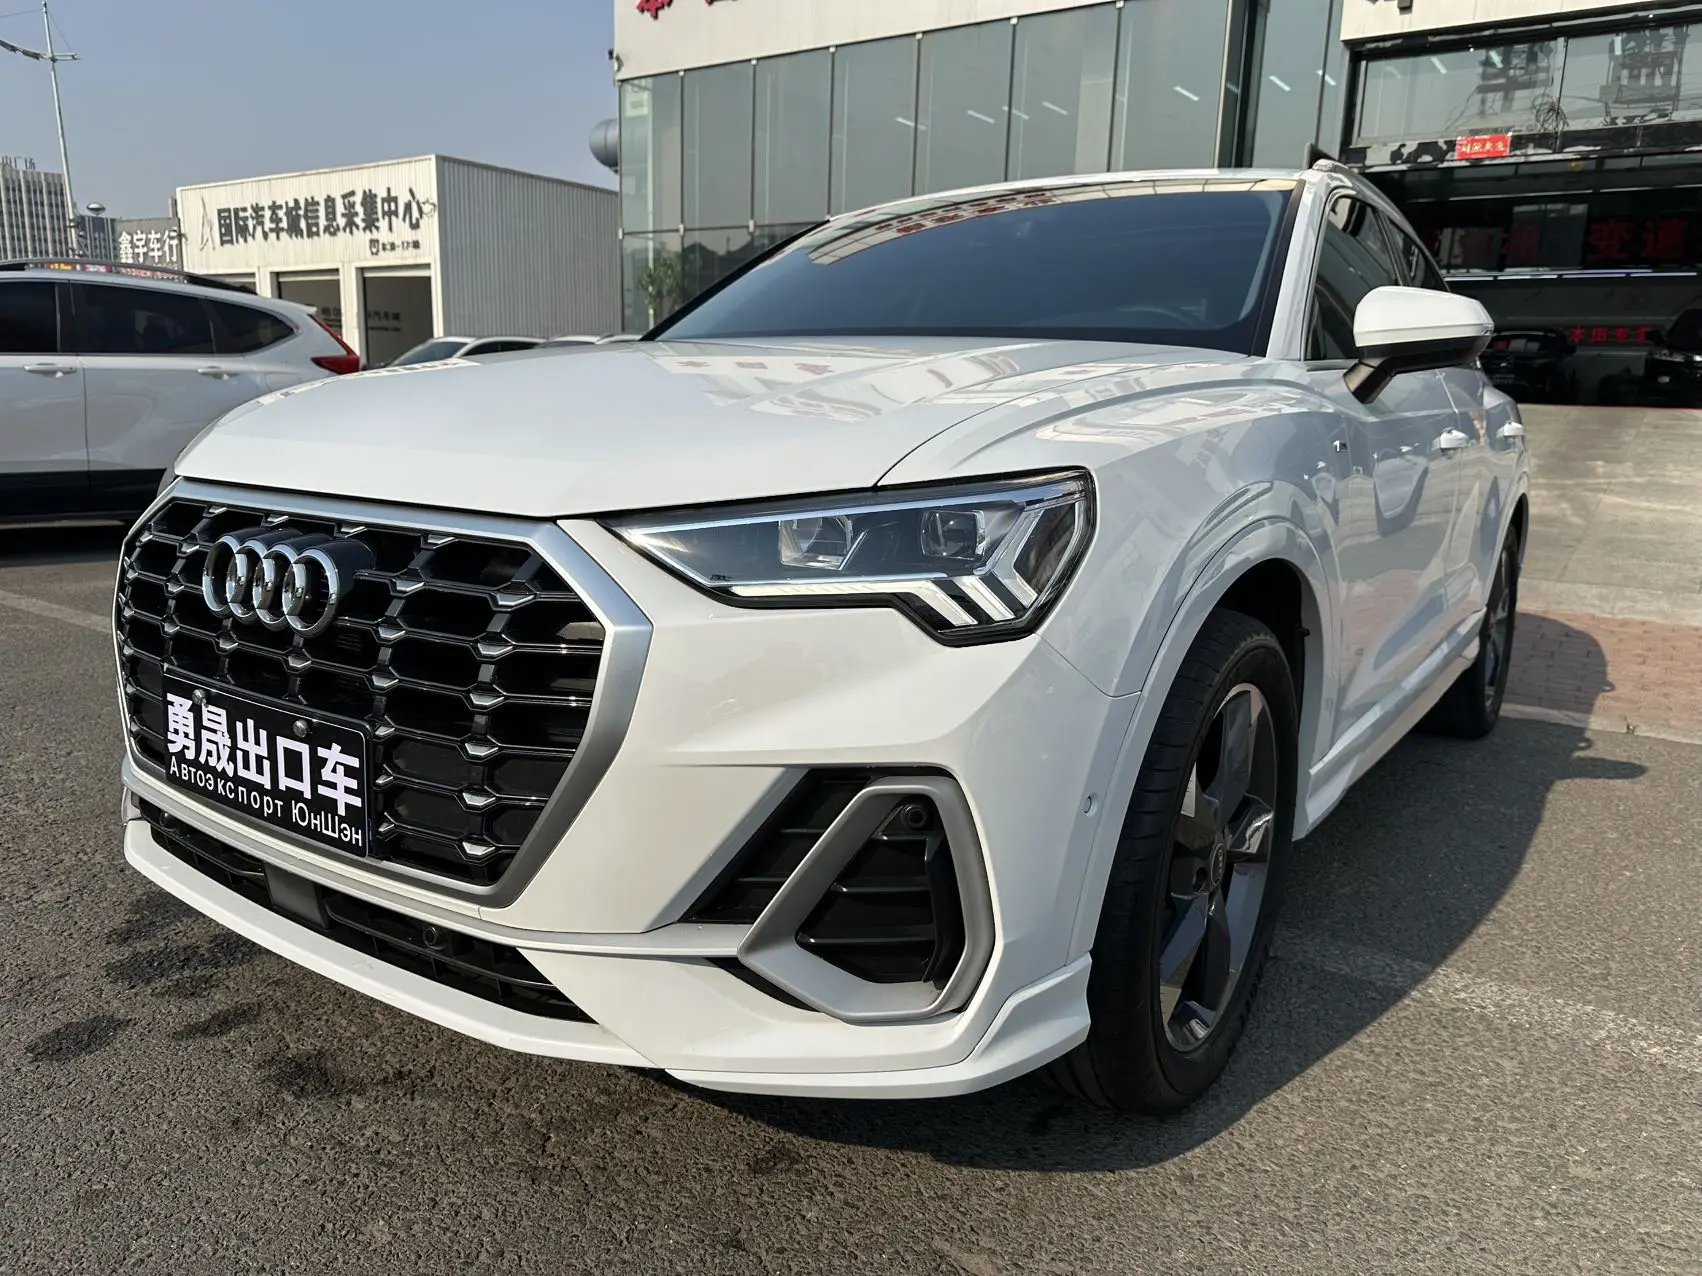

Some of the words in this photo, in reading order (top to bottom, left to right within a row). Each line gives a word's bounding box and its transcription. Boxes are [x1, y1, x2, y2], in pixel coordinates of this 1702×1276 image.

[118, 229, 179, 264] 鑫宇车行
[217, 187, 423, 247] 国际汽车城信息采集中心
[166, 692, 362, 817] 勇晟出口车
[169, 755, 285, 818] Автоэкспорт
[291, 799, 363, 847] ЮнШэн
